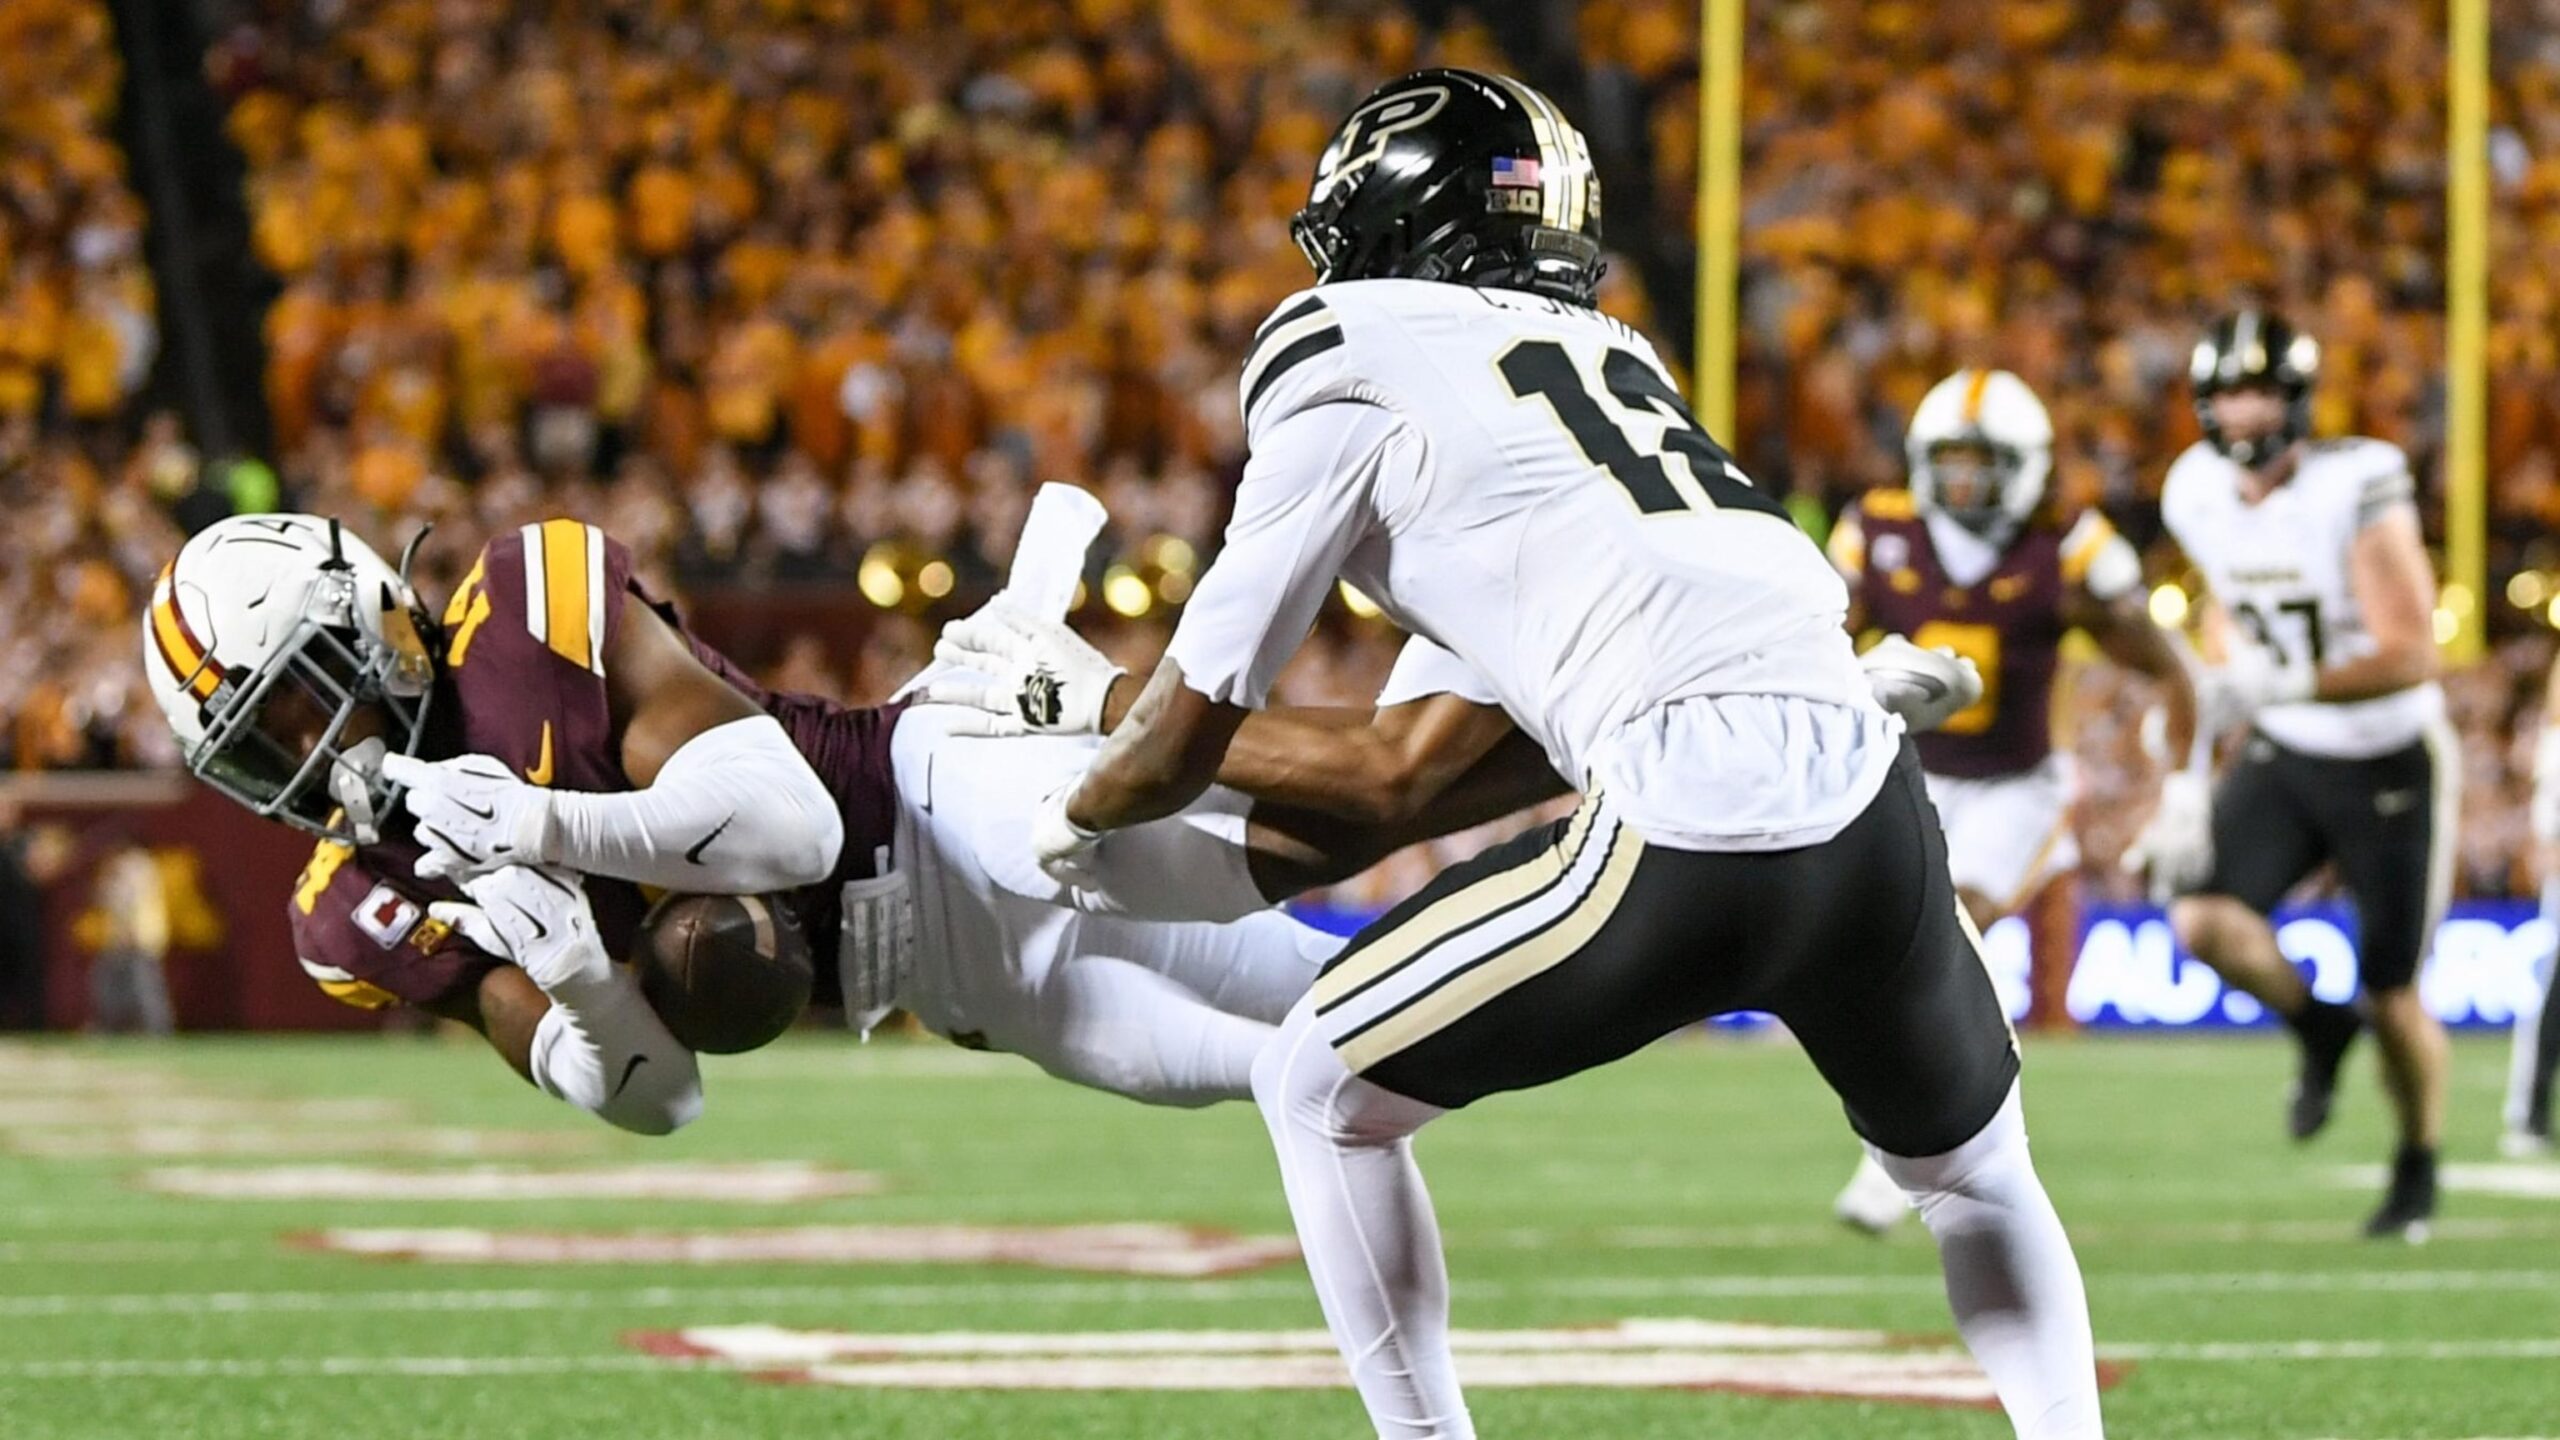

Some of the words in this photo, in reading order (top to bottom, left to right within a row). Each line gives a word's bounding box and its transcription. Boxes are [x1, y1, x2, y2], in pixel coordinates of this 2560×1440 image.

[1330, 86, 1450, 182] P
[1494, 338, 1796, 527] 12
[356, 884, 416, 942] C
